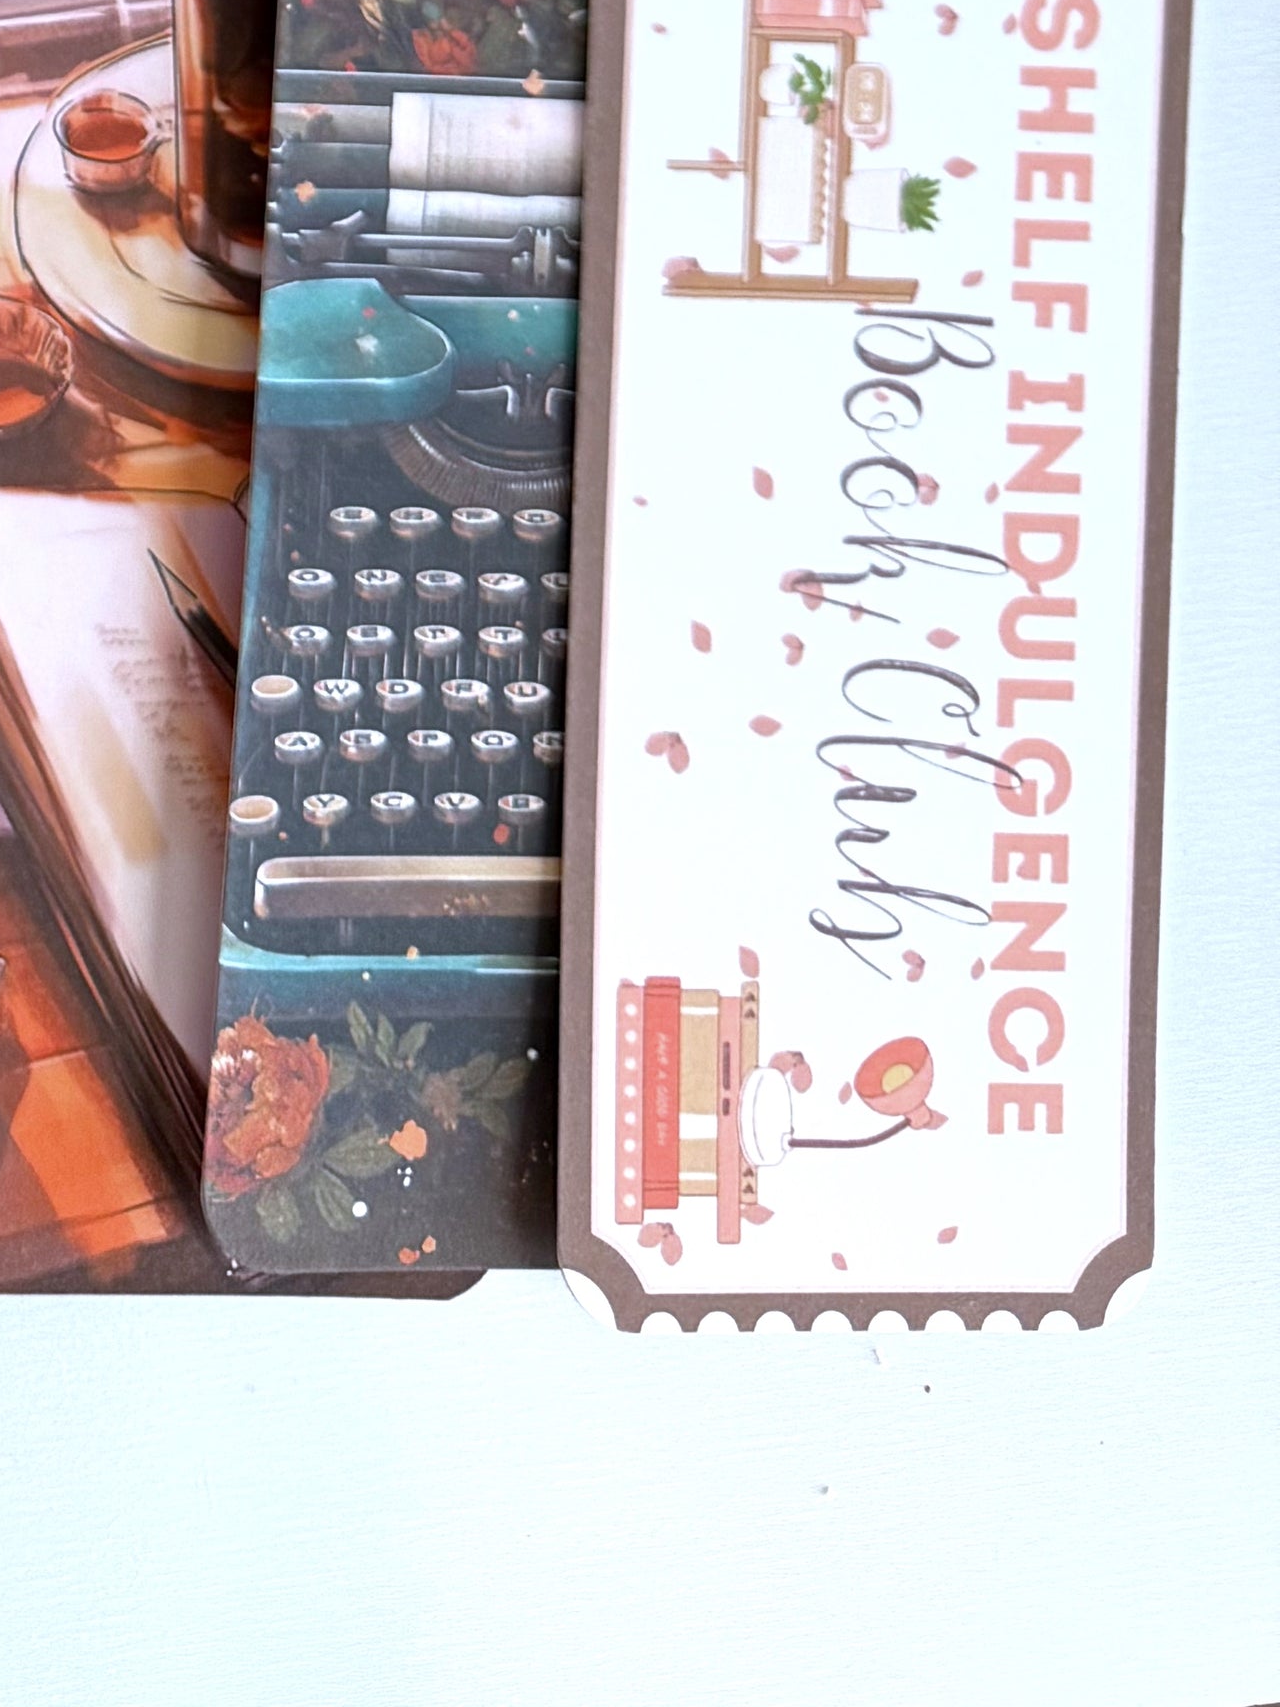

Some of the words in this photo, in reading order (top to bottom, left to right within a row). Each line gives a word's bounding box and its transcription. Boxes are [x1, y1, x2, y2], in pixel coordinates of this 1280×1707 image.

[791, 308, 1009, 623] Book
[809, 658, 1023, 981] Club
[986, 370, 1086, 1137] INDULGENCE
